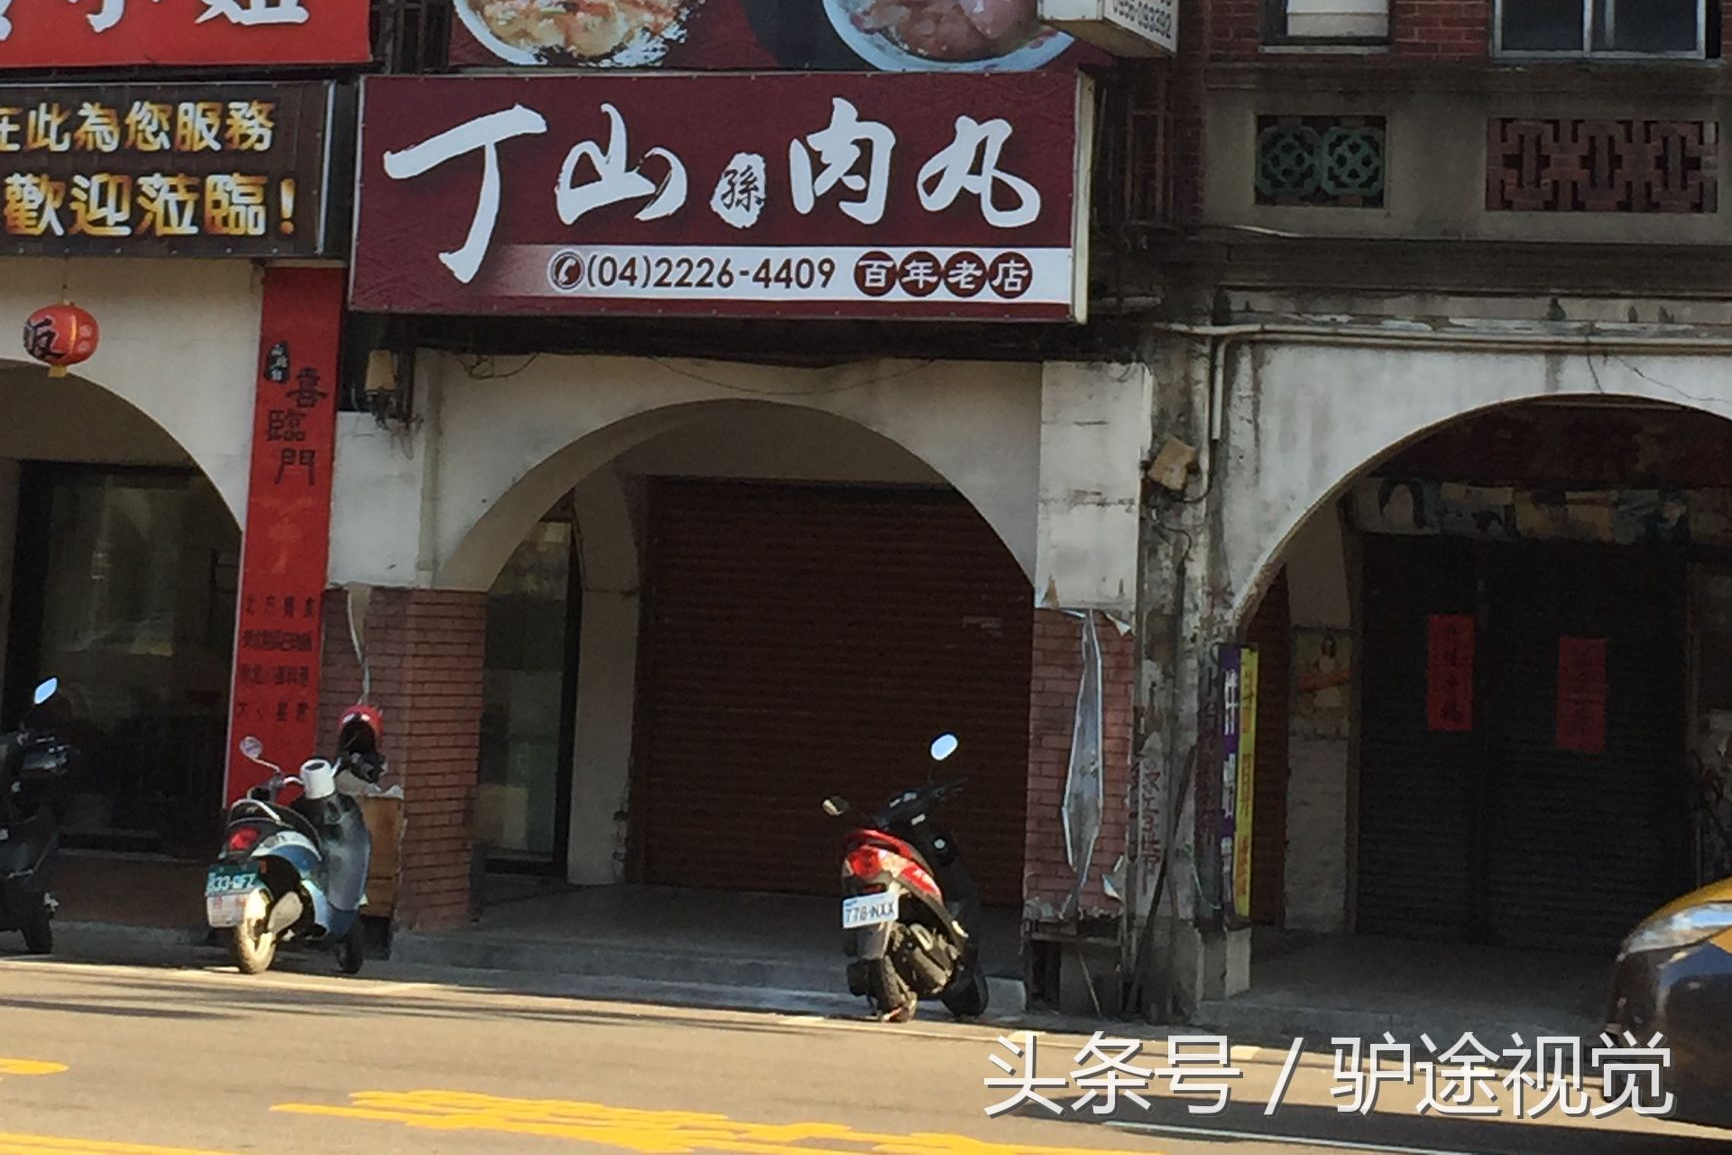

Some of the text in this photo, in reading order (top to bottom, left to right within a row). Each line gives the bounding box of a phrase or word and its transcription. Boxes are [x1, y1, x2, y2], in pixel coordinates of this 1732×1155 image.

[587, 255, 1032, 295] (04)2226-4409 百年老店
